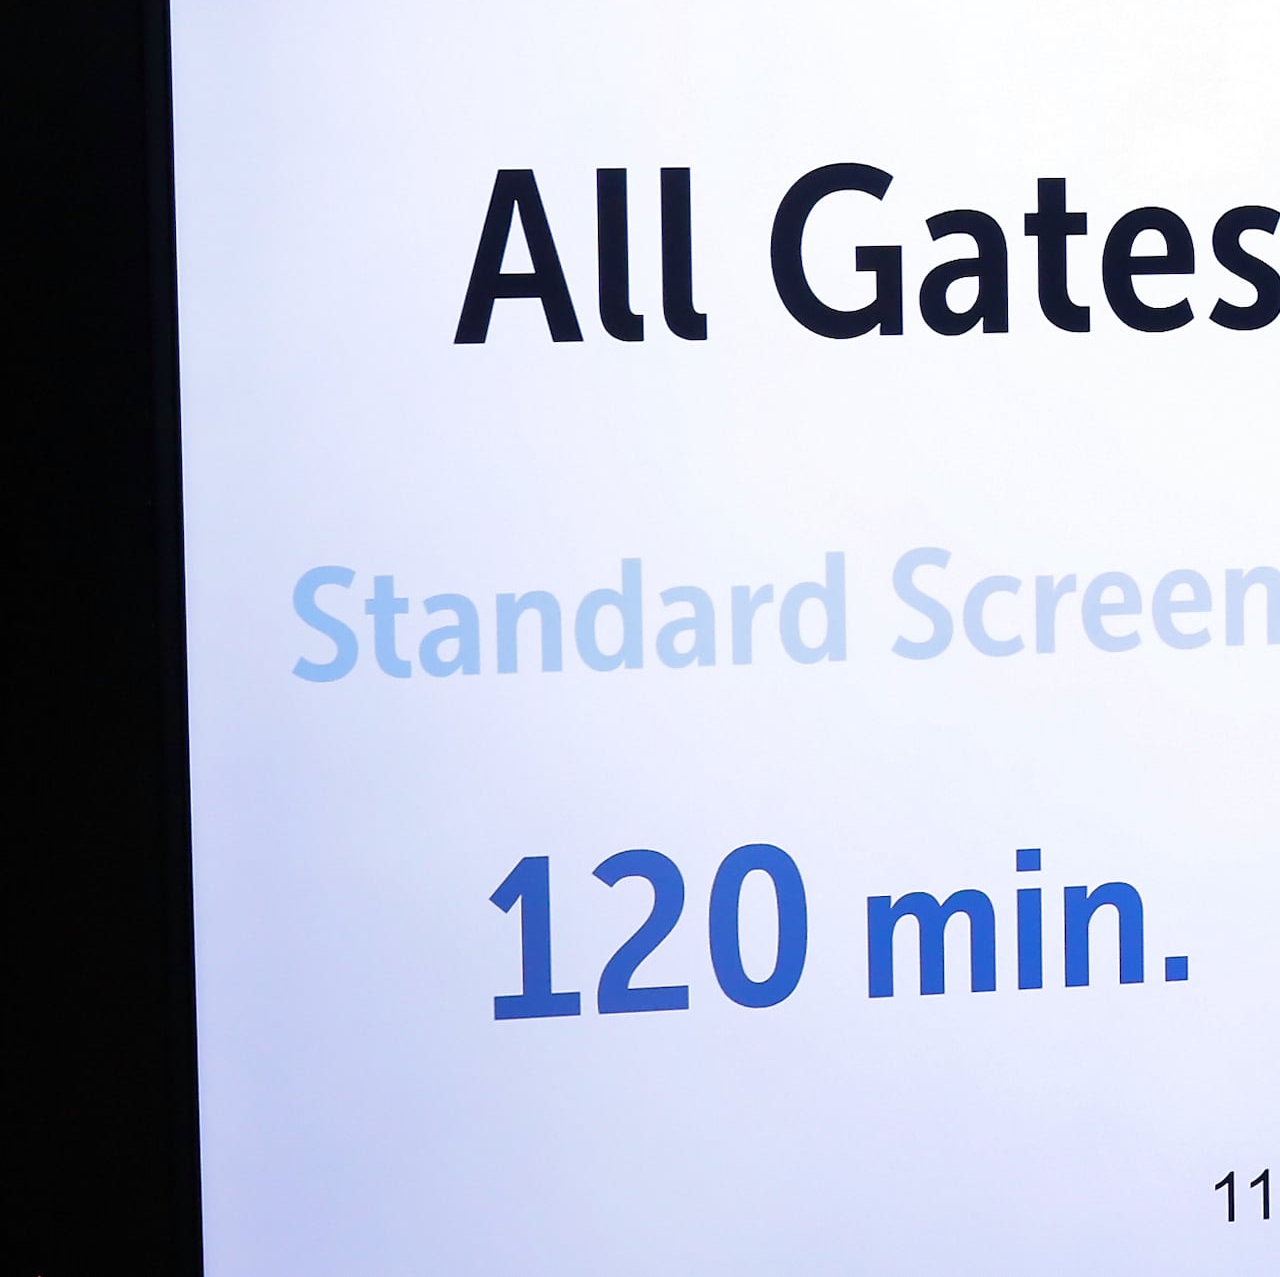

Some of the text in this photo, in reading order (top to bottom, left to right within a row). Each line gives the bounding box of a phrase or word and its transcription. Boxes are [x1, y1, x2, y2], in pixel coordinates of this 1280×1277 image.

[454, 168, 707, 344] All
[292, 552, 847, 682] Standard
[489, 844, 1188, 1020] 120 min.
